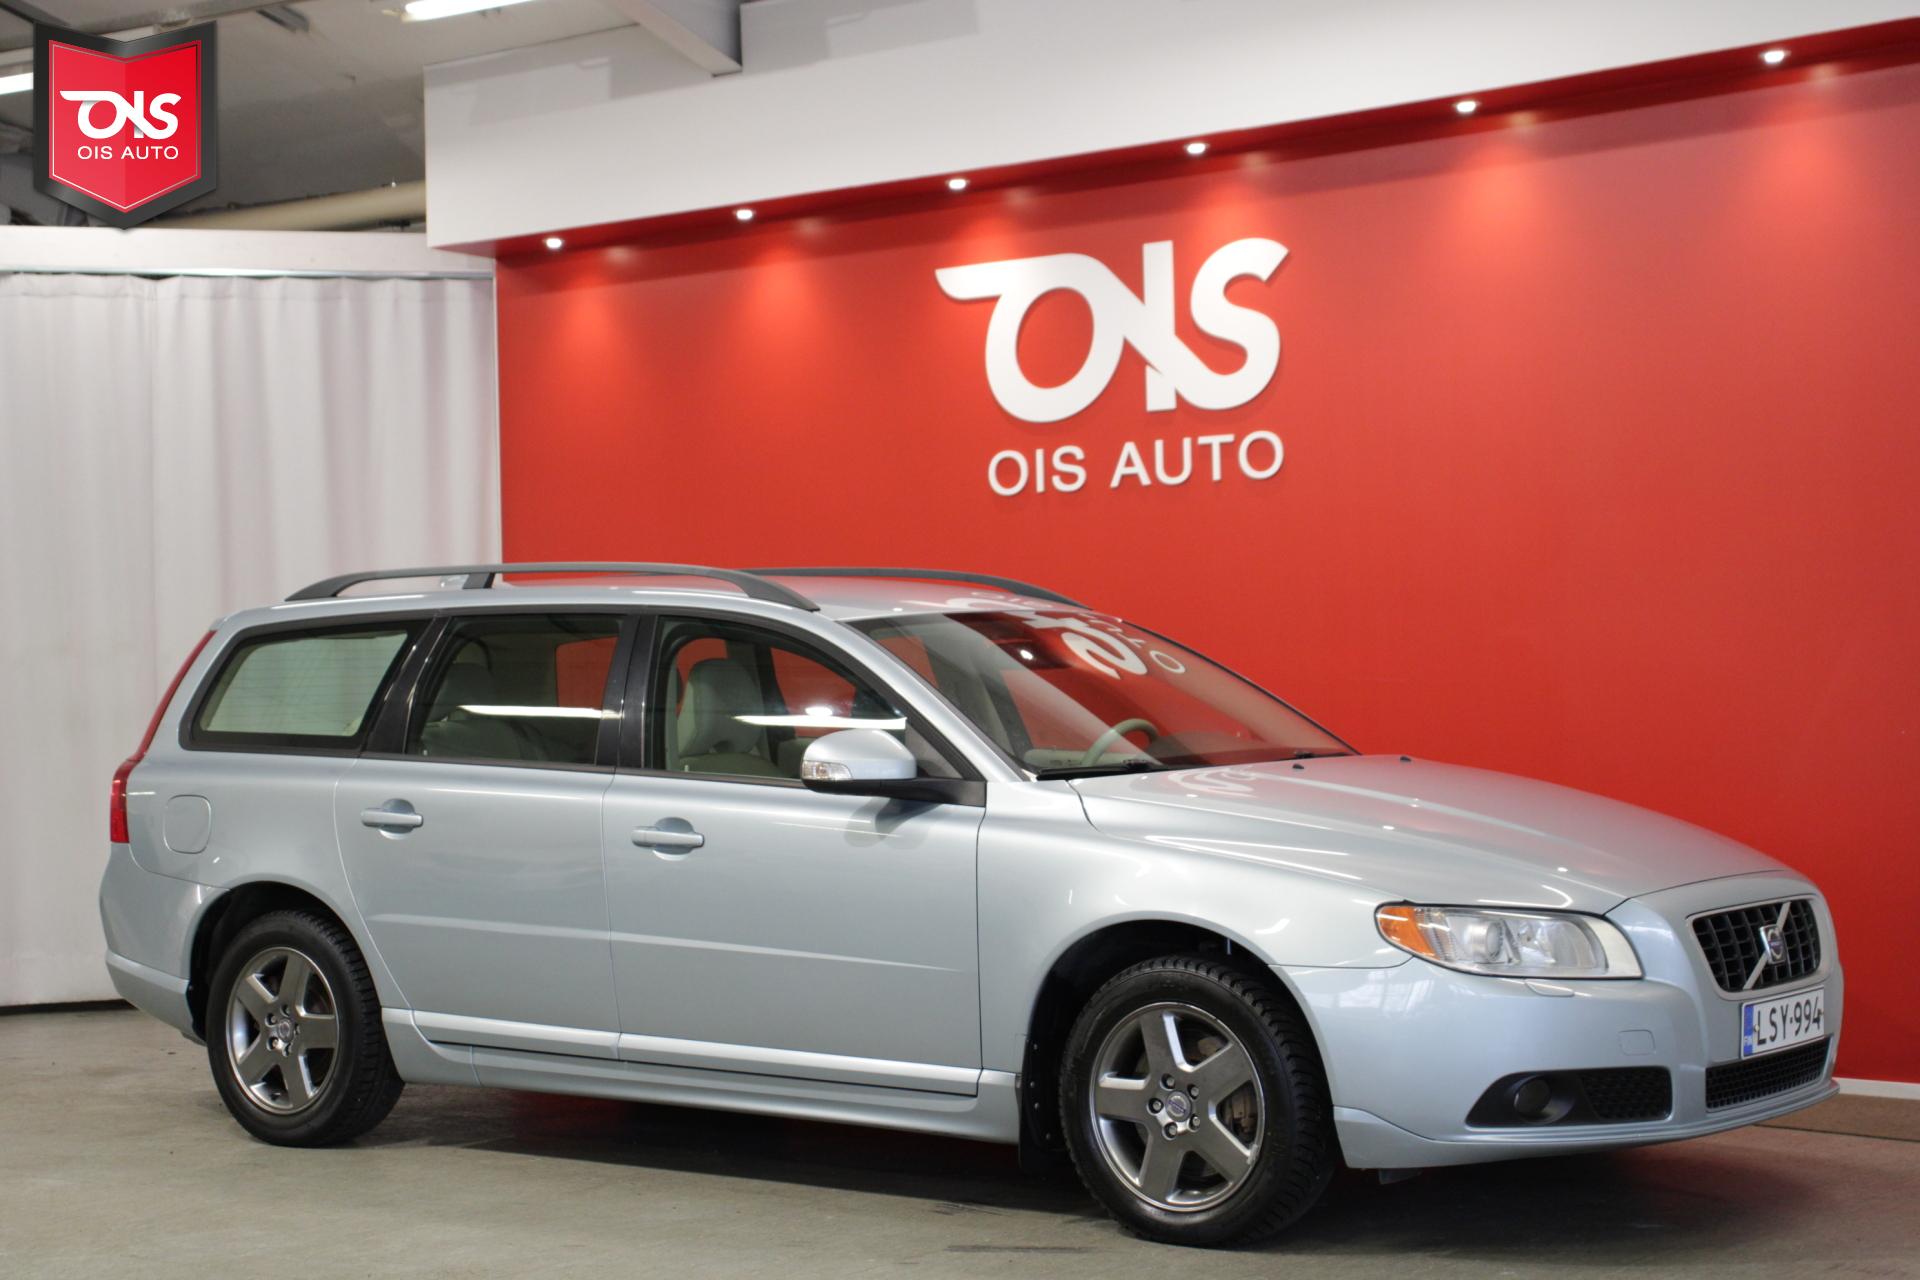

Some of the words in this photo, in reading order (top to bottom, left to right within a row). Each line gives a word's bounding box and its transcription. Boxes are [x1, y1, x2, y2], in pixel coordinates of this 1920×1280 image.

[988, 445, 1087, 496] OIS
[1110, 430, 1284, 488] AUTO
[1757, 996, 1822, 1046] LSY-994
